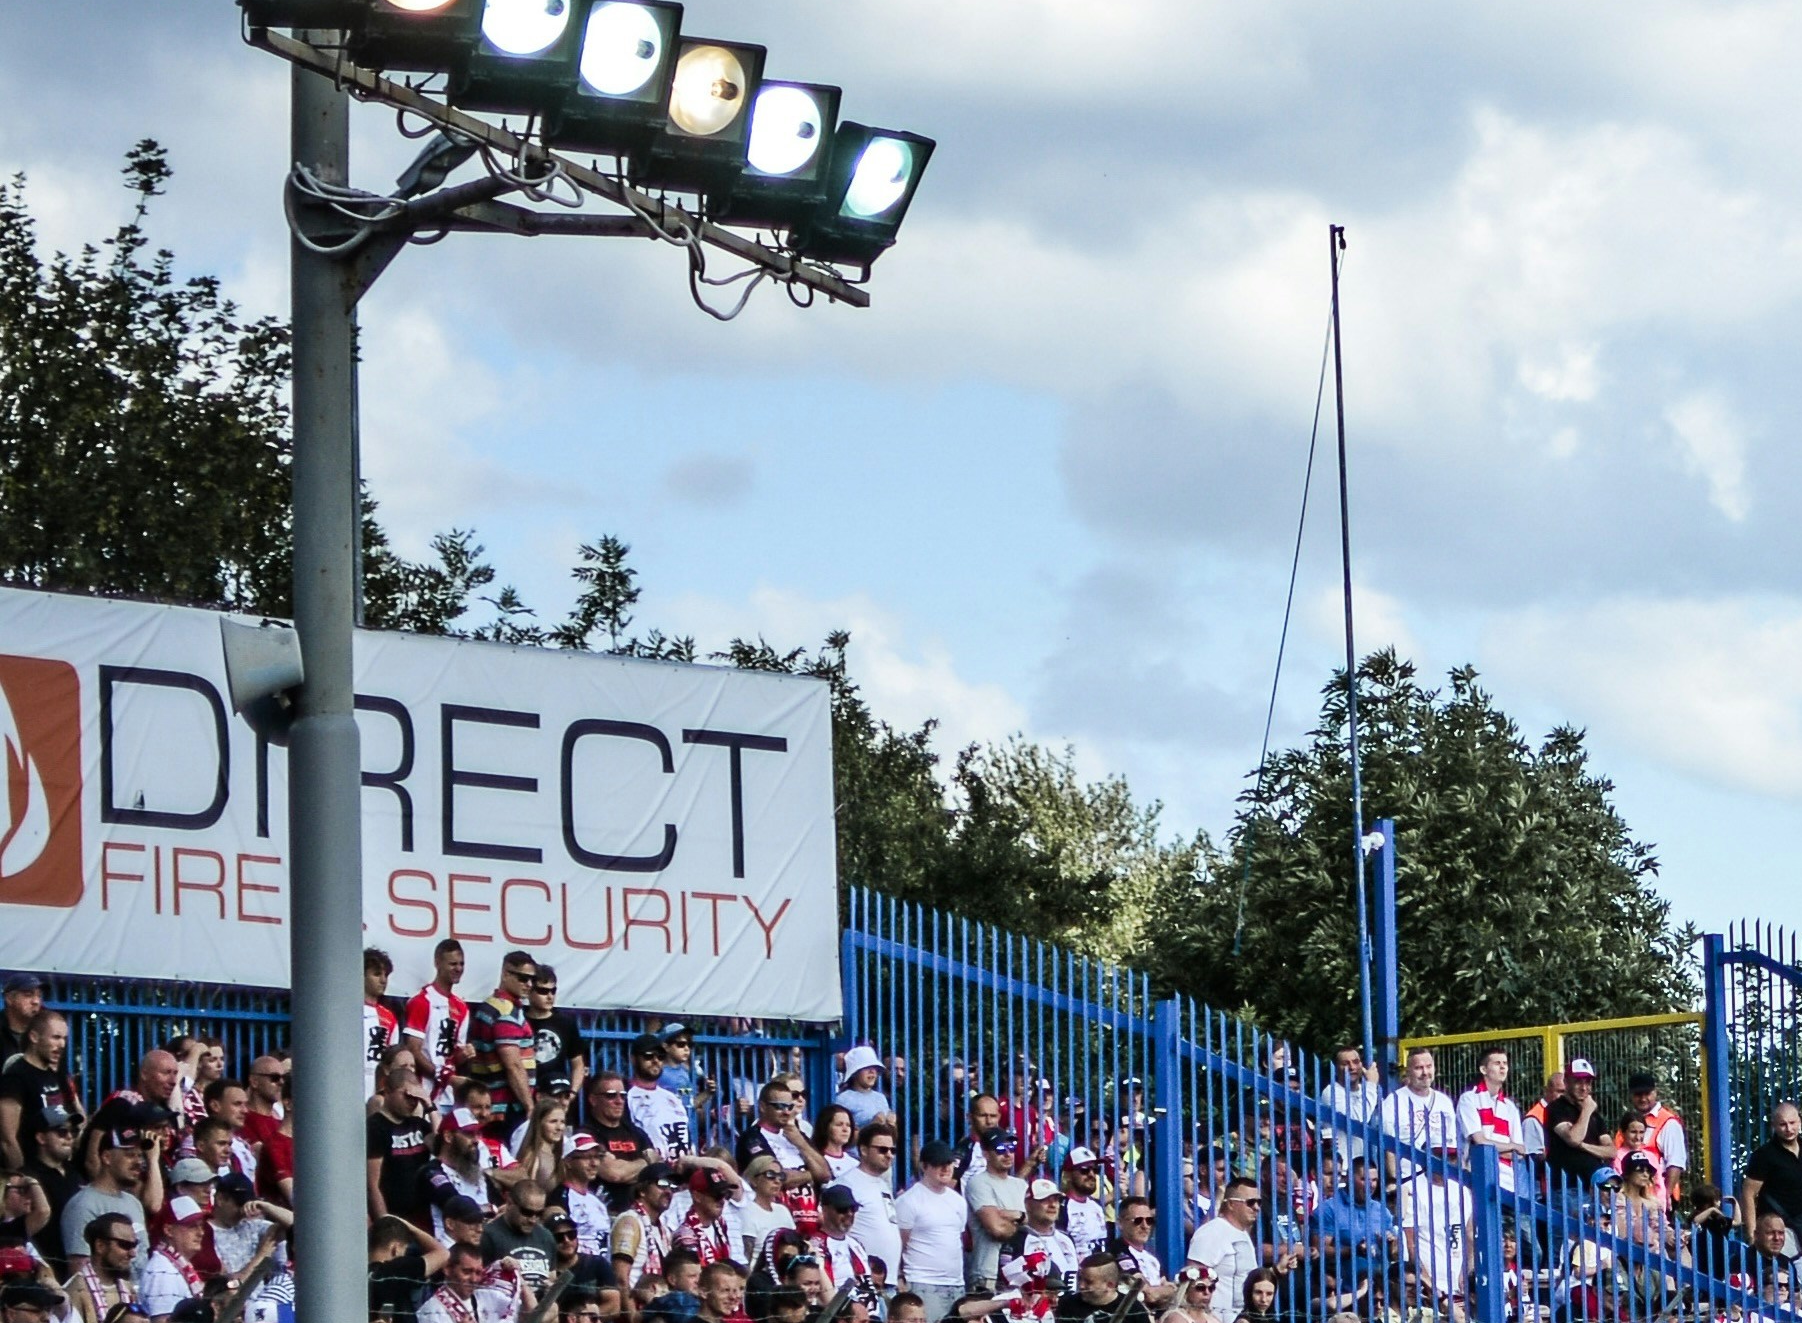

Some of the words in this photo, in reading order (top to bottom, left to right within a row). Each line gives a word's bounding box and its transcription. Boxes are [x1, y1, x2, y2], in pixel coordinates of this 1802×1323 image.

[100, 665, 788, 879] DIRECT
[103, 842, 282, 925] FIRE
[388, 869, 792, 959] SECURITY
